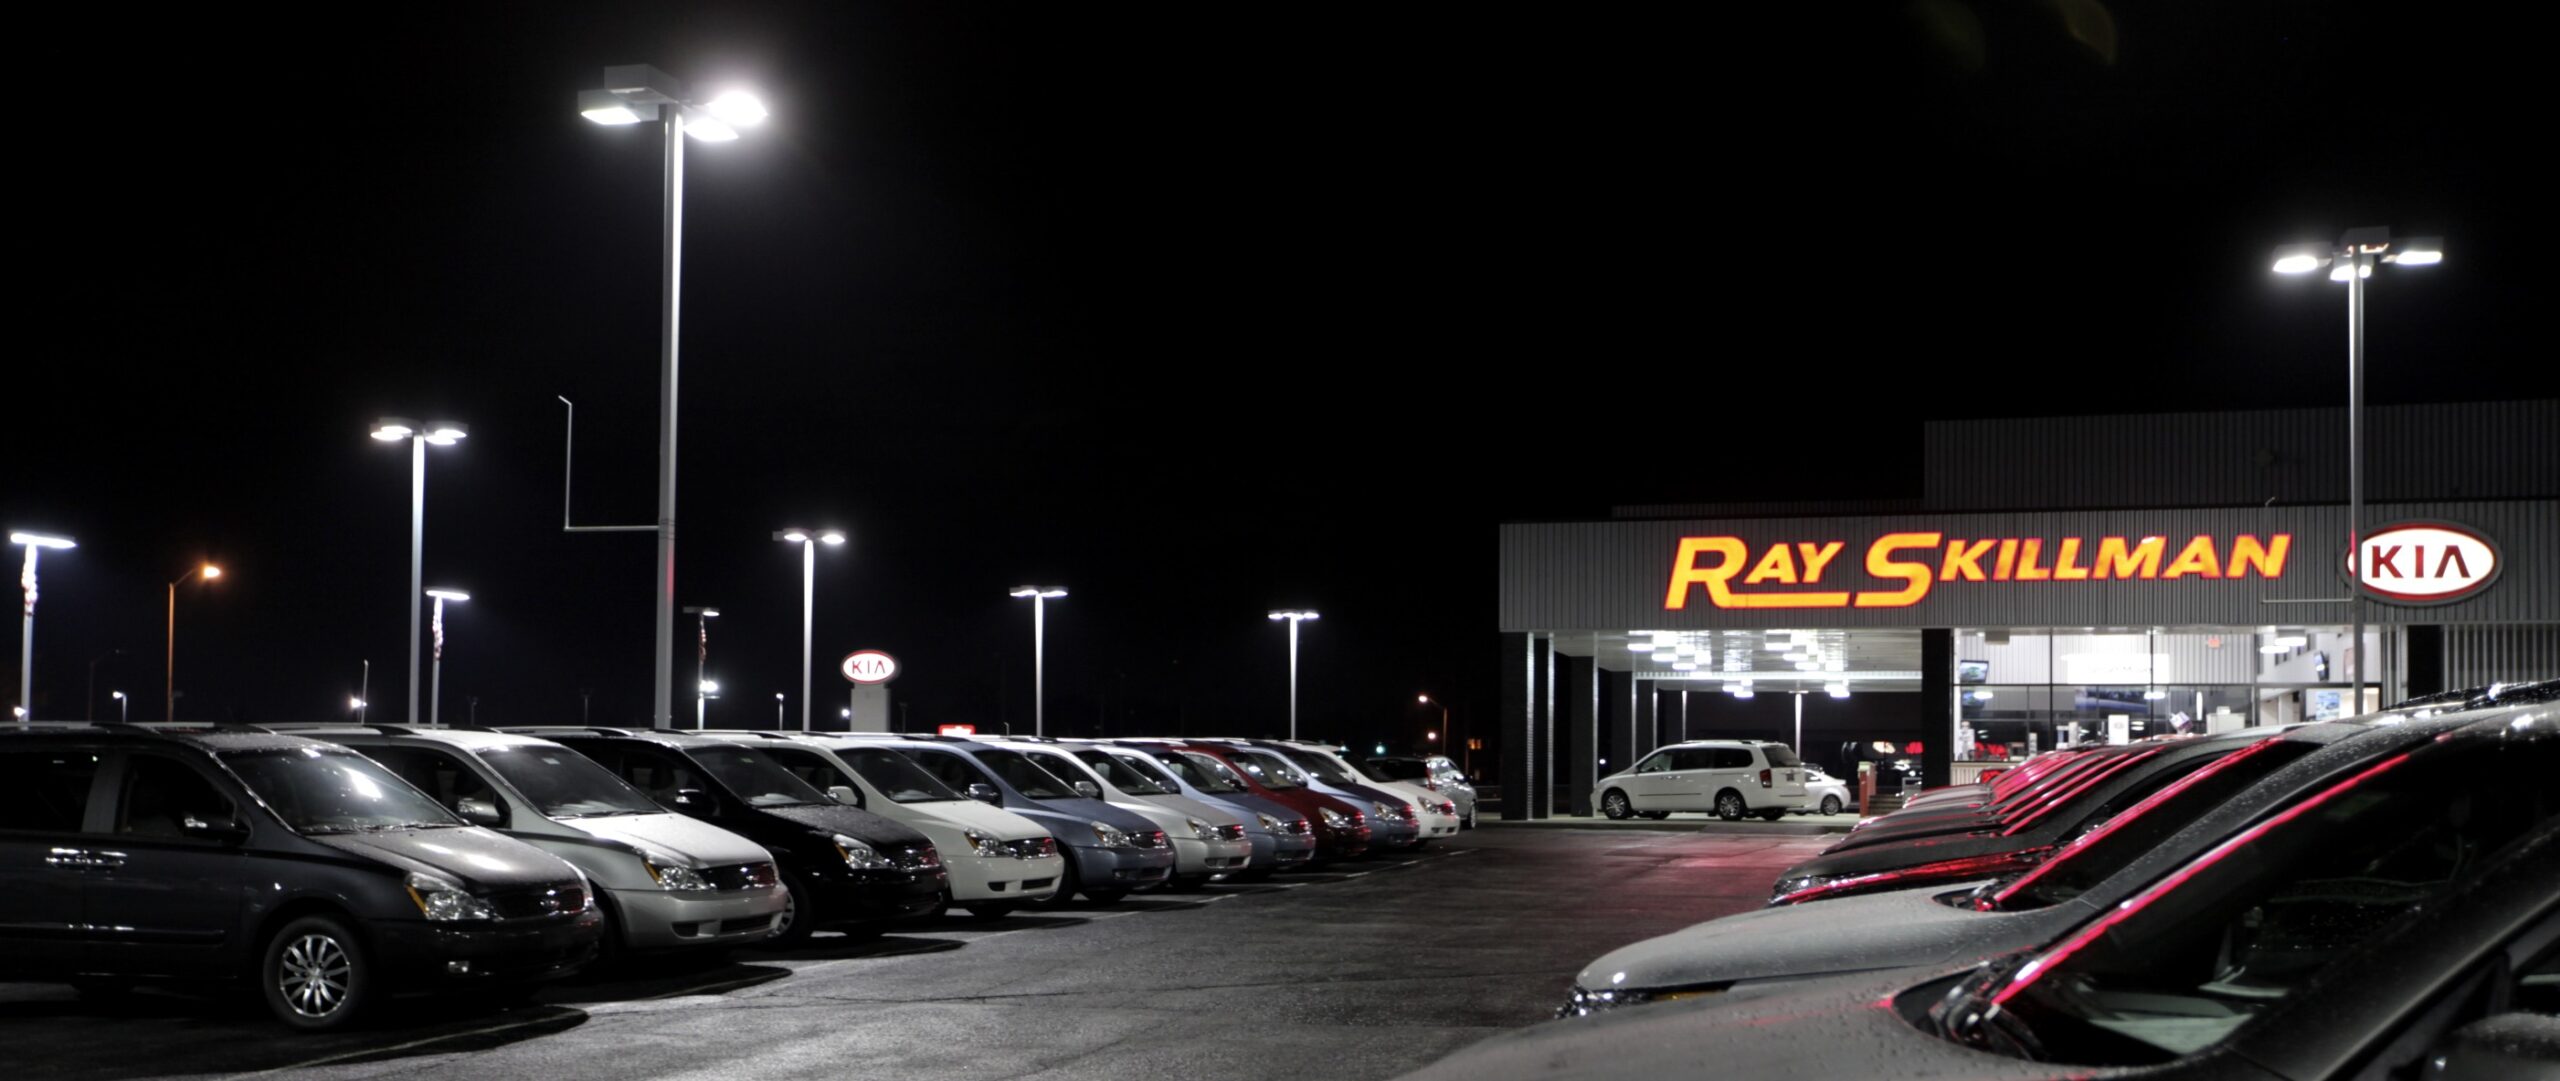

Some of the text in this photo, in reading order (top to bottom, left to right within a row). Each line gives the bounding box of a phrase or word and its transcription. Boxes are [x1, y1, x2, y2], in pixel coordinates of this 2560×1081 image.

[1664, 532, 2292, 609] RAY SKILLMAN
[2371, 544, 2472, 579] KIA
[852, 660, 886, 674] KIA
